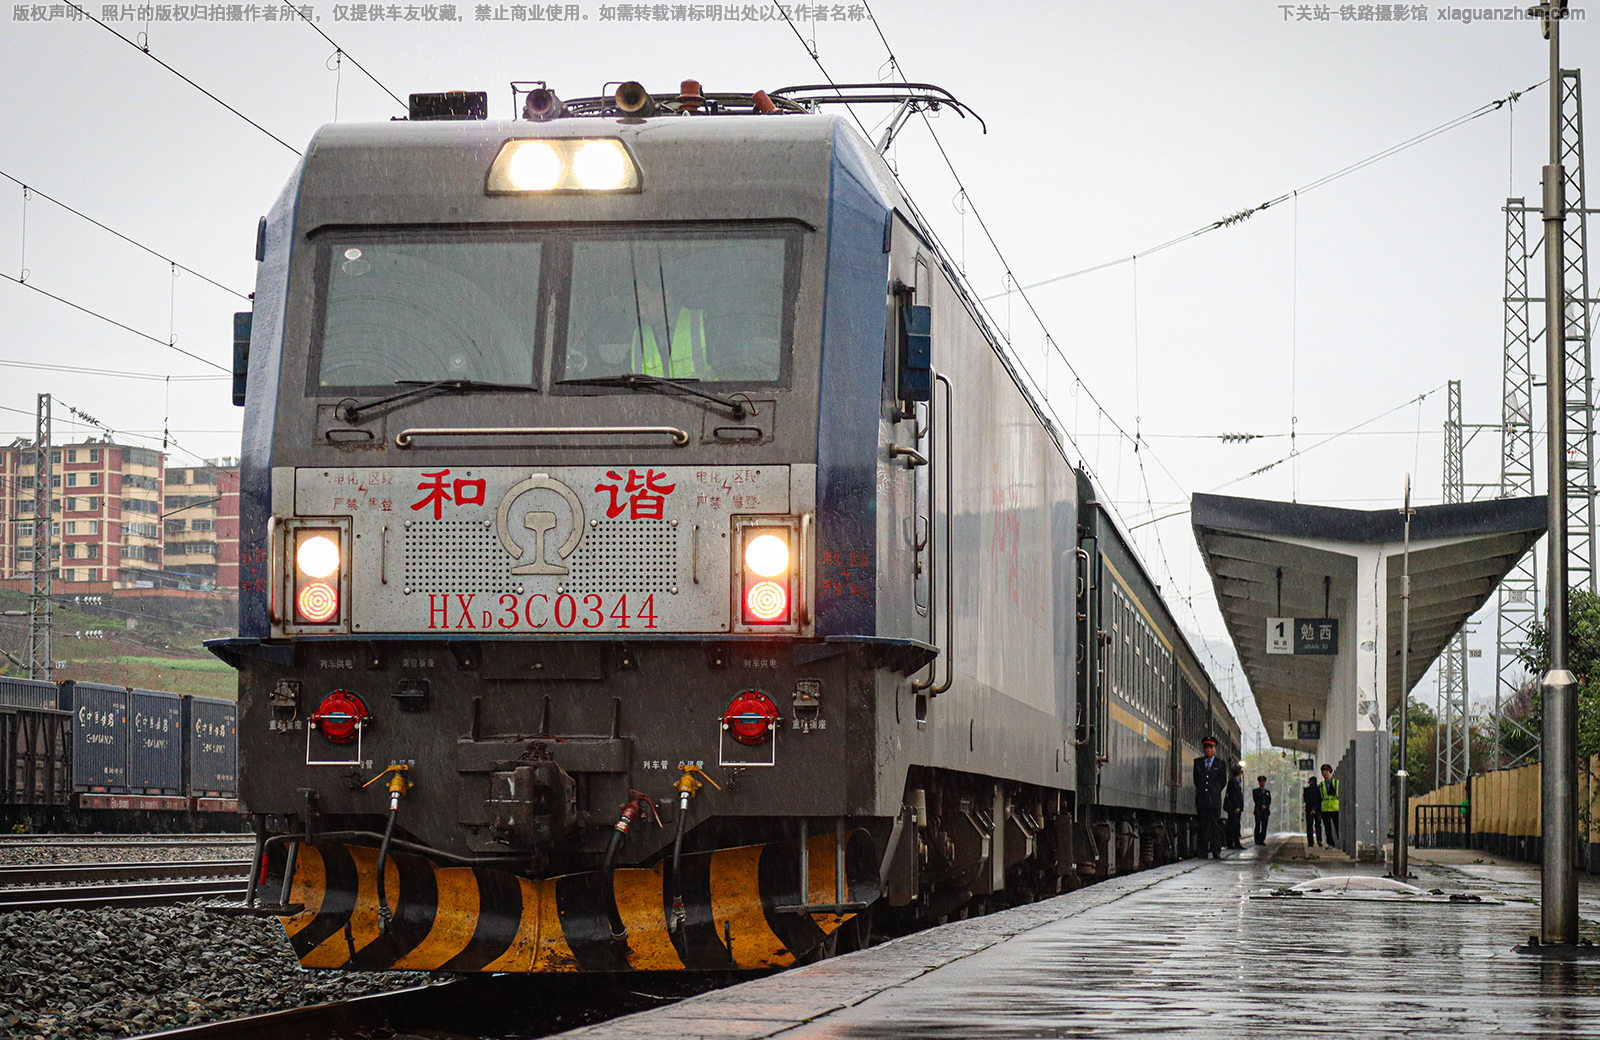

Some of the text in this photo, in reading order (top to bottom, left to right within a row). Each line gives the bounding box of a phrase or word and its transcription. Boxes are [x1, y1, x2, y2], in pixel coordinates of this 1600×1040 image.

[411, 468, 676, 521] 和 谐
[1276, 622, 1285, 638] 1
